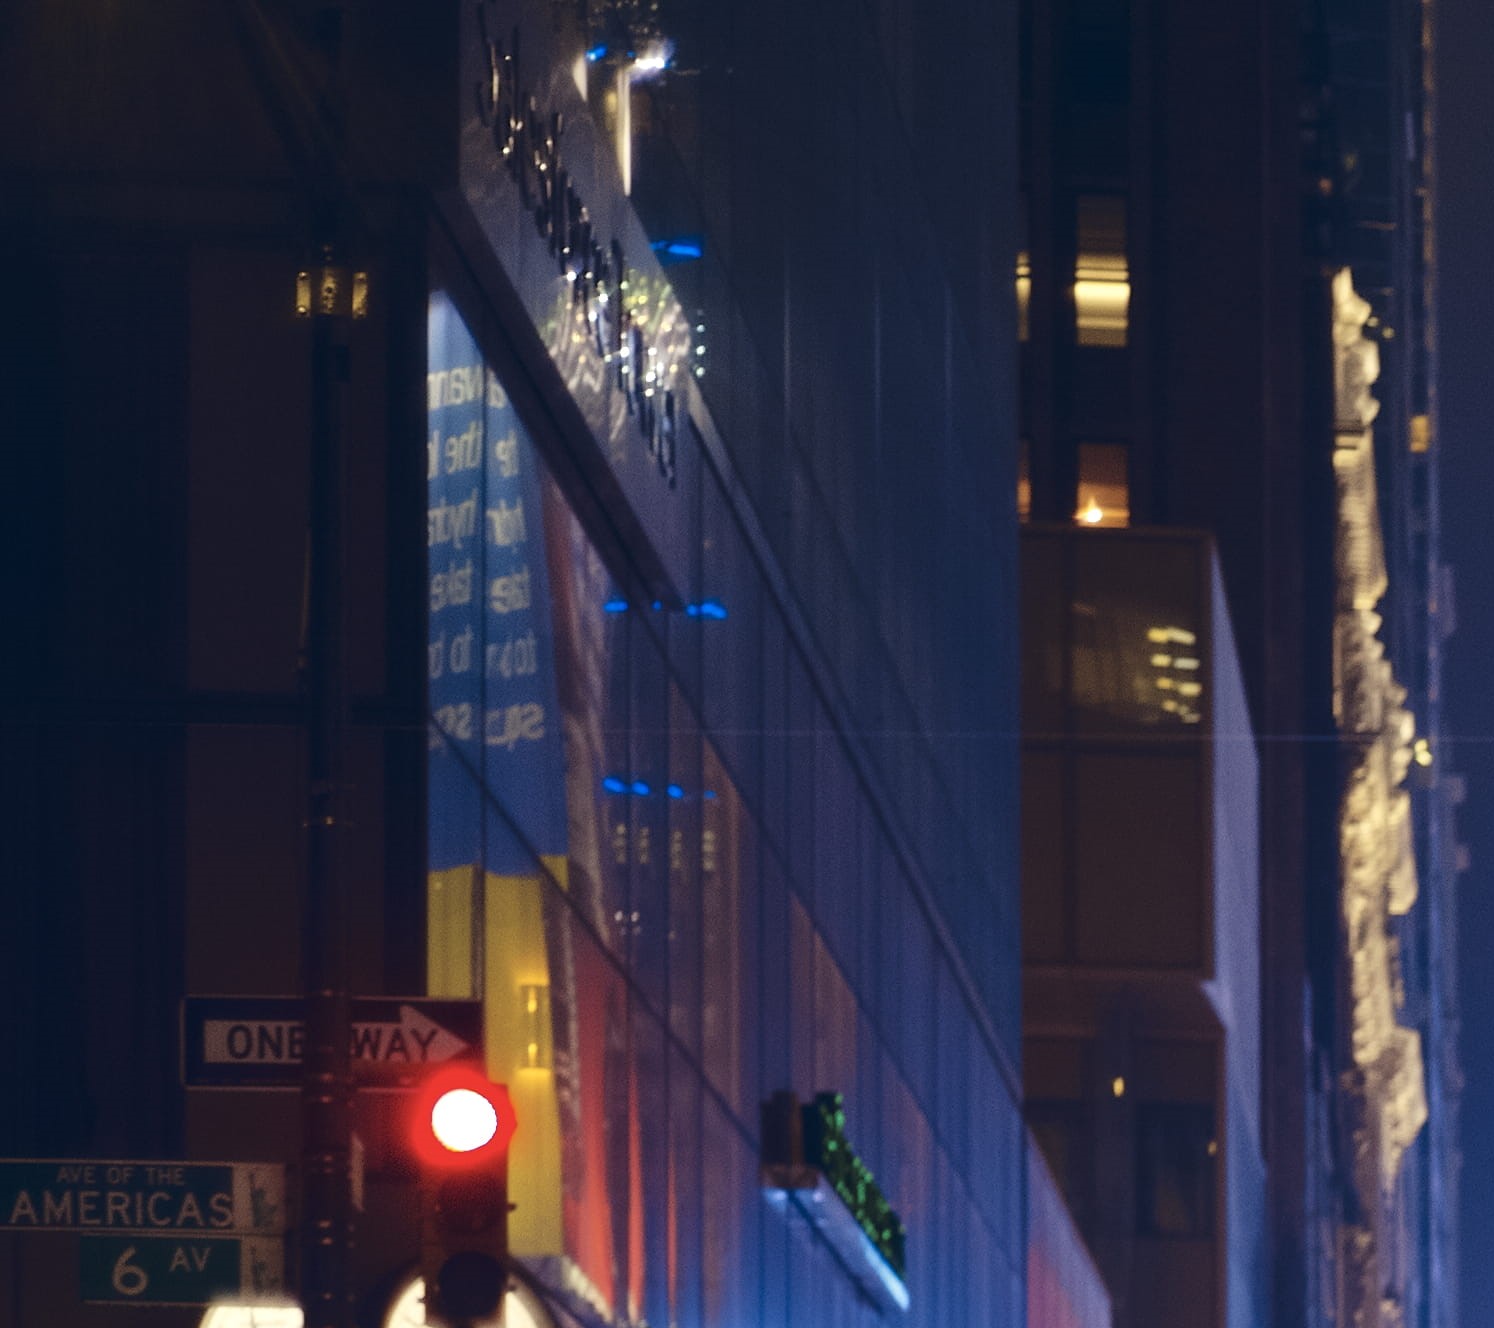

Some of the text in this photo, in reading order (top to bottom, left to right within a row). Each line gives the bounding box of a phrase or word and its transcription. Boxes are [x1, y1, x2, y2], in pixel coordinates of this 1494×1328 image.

[227, 1025, 438, 1062] ONE WAY
[56, 1165, 186, 1188] AVE OF THE
[8, 1188, 234, 1229] AMERICAS
[112, 1245, 212, 1297] 6 AV
